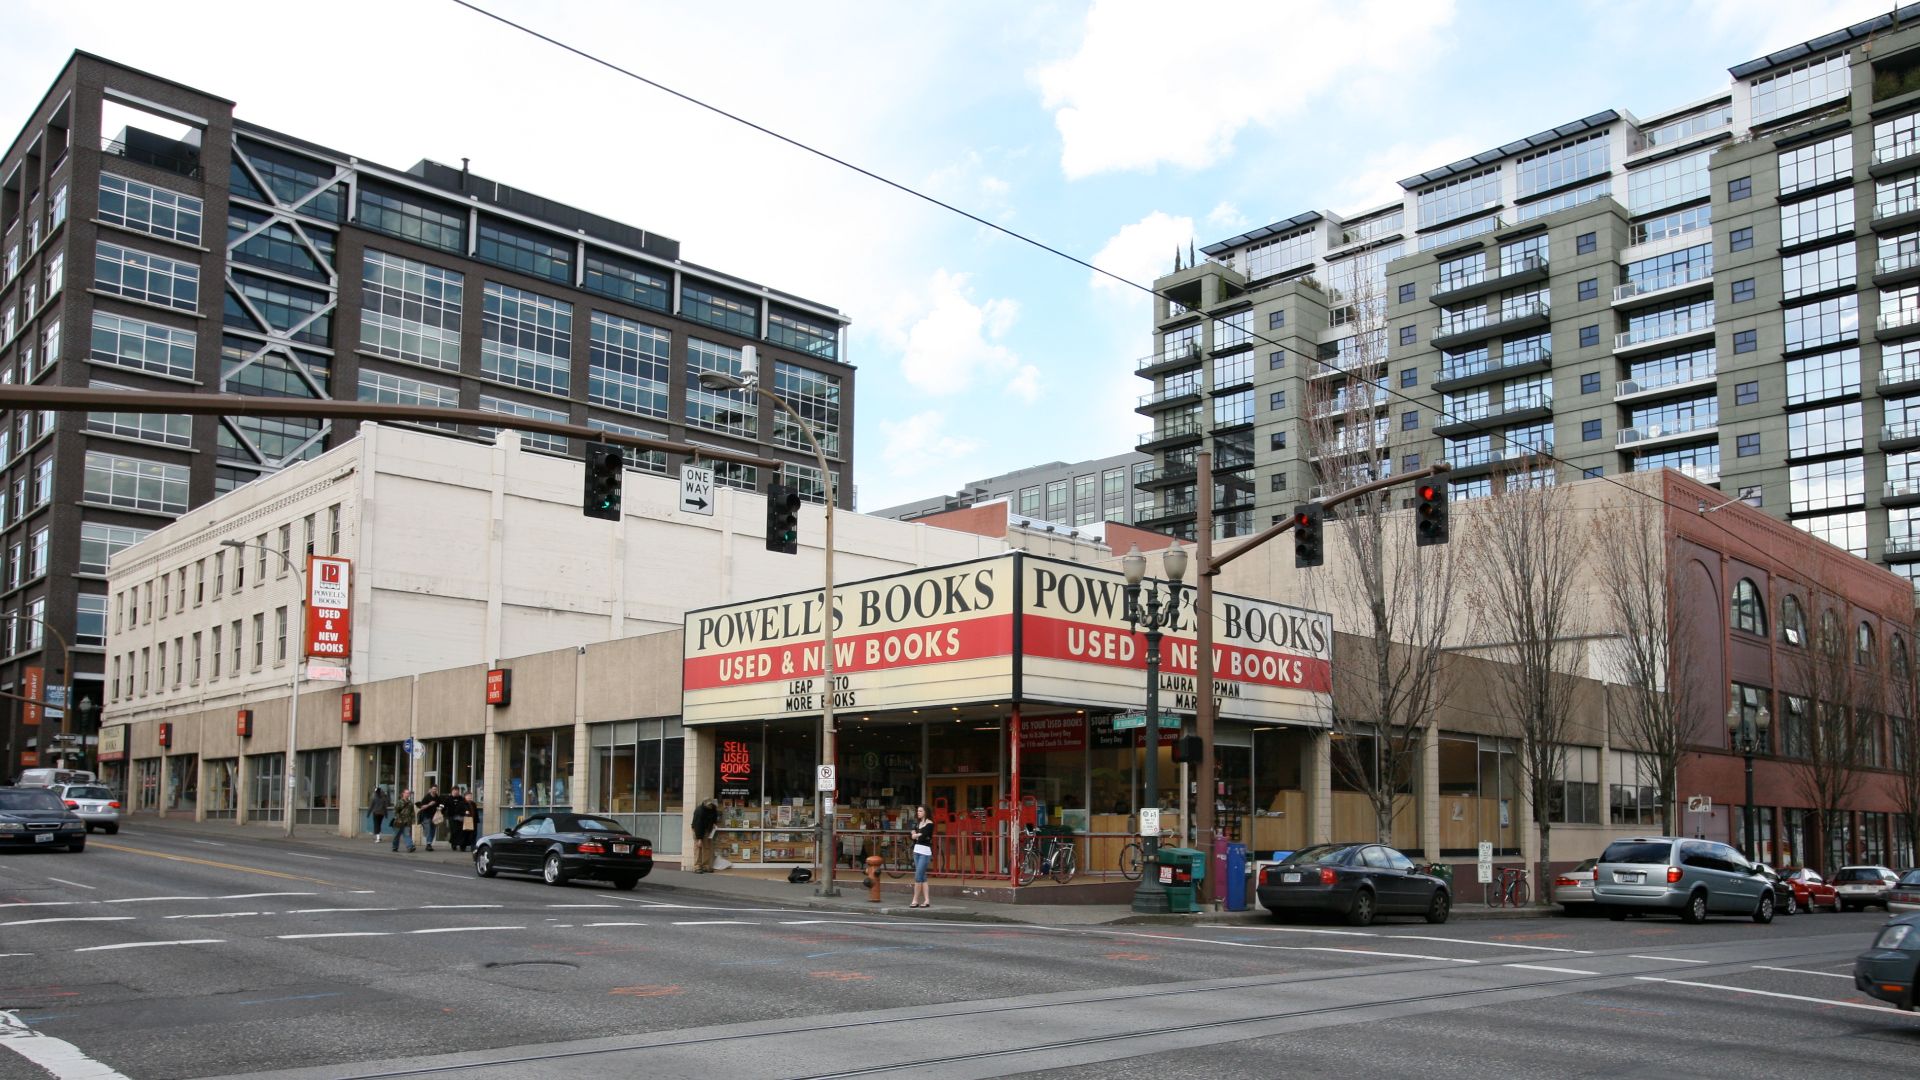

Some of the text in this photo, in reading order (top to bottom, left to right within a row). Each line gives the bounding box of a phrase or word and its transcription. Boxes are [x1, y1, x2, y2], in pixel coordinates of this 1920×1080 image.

[687, 469, 709, 483] ONE
[686, 482, 709, 495] WAY
[314, 589, 346, 599] POWELL'S
[318, 597, 342, 605] BOOKS
[319, 609, 340, 619] USED
[697, 568, 995, 651] POWELL'S BOOKS
[1033, 568, 1327, 653] POW' BOOKS
[325, 620, 333, 630] &
[319, 632, 338, 642] NEW
[314, 642, 344, 653] BOOKS
[719, 628, 961, 681] USED & NW BOOKS
[1068, 627, 1135, 662] USED
[1231, 654, 1304, 684] BOOKS
[789, 676, 849, 695] LEAP TO
[1160, 675, 1240, 698] LAURA PMAN
[786, 692, 856, 712] MORE BOKS
[1047, 719, 1062, 728] USED
[723, 741, 749, 752] SELL
[723, 752, 749, 763] USED
[720, 763, 751, 774] BOOKS
